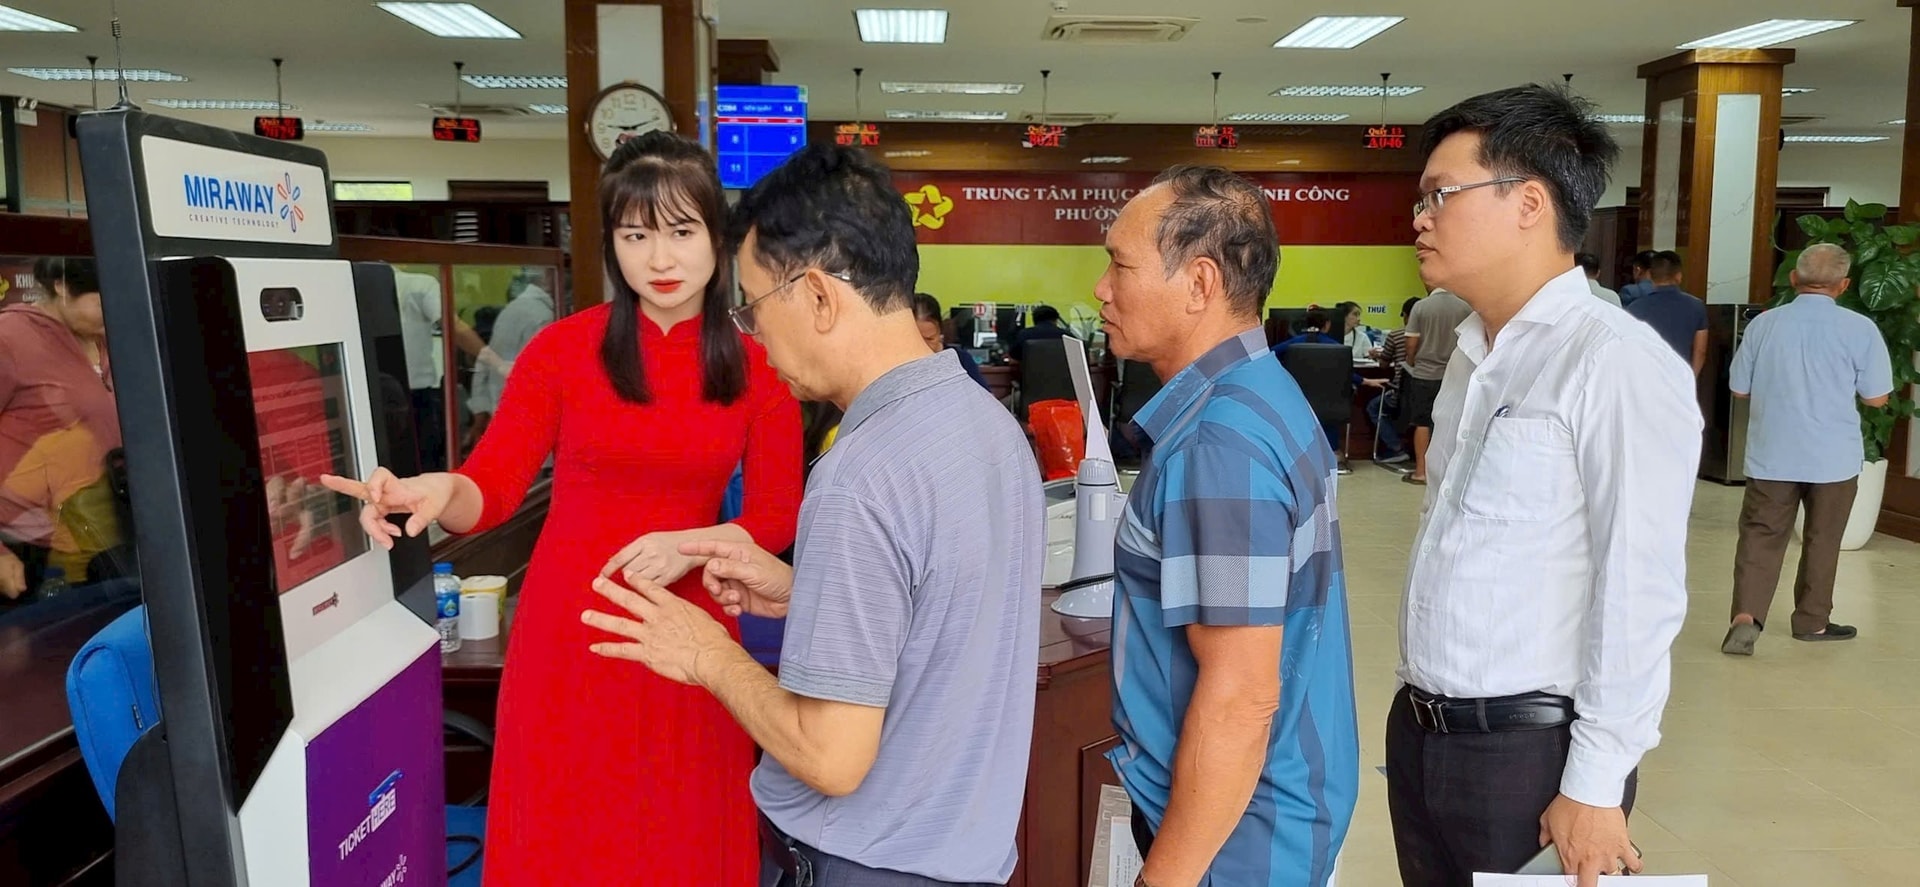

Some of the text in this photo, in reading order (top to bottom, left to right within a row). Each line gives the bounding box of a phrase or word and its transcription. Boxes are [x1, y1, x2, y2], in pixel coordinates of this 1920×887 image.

[184, 174, 274, 215] MIRAWAY
[962, 187, 1030, 200] TRUNG
[1034, 185, 1076, 200] TÂM
[1083, 188, 1134, 203] PHỤC
[1295, 186, 1350, 201] CÔNG
[189, 214, 280, 229] CREATIVE TECHNOLOGY
[1367, 304, 1387, 314] THUẾ
[339, 790, 396, 860] TICKET HERE
